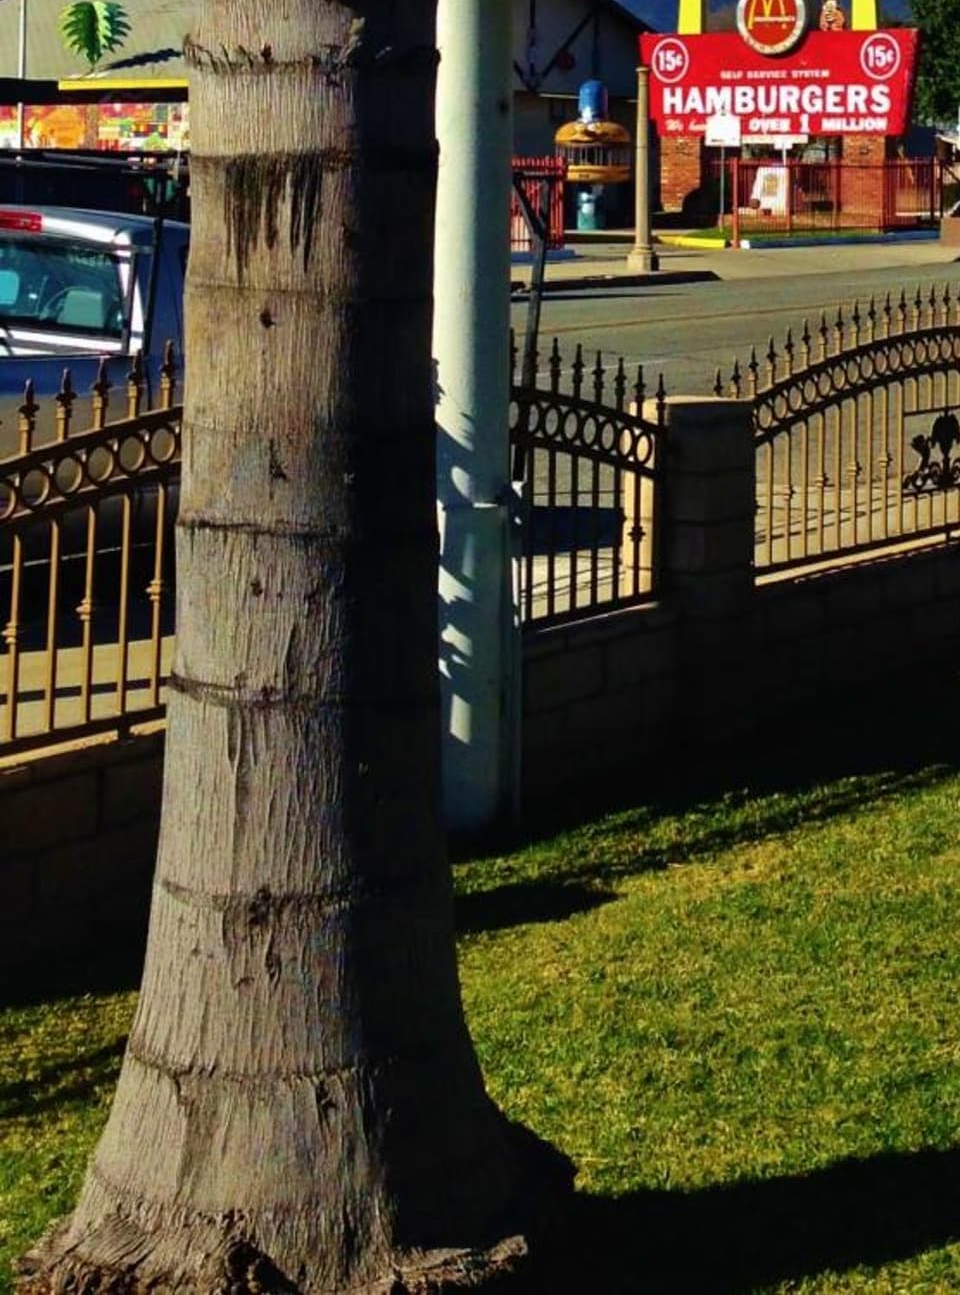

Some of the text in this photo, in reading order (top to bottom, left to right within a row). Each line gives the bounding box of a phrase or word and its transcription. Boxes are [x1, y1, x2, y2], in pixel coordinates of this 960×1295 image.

[663, 84, 891, 115] HAMBURGERS
[748, 117, 791, 133] OVER
[821, 117, 888, 132] MILLION
